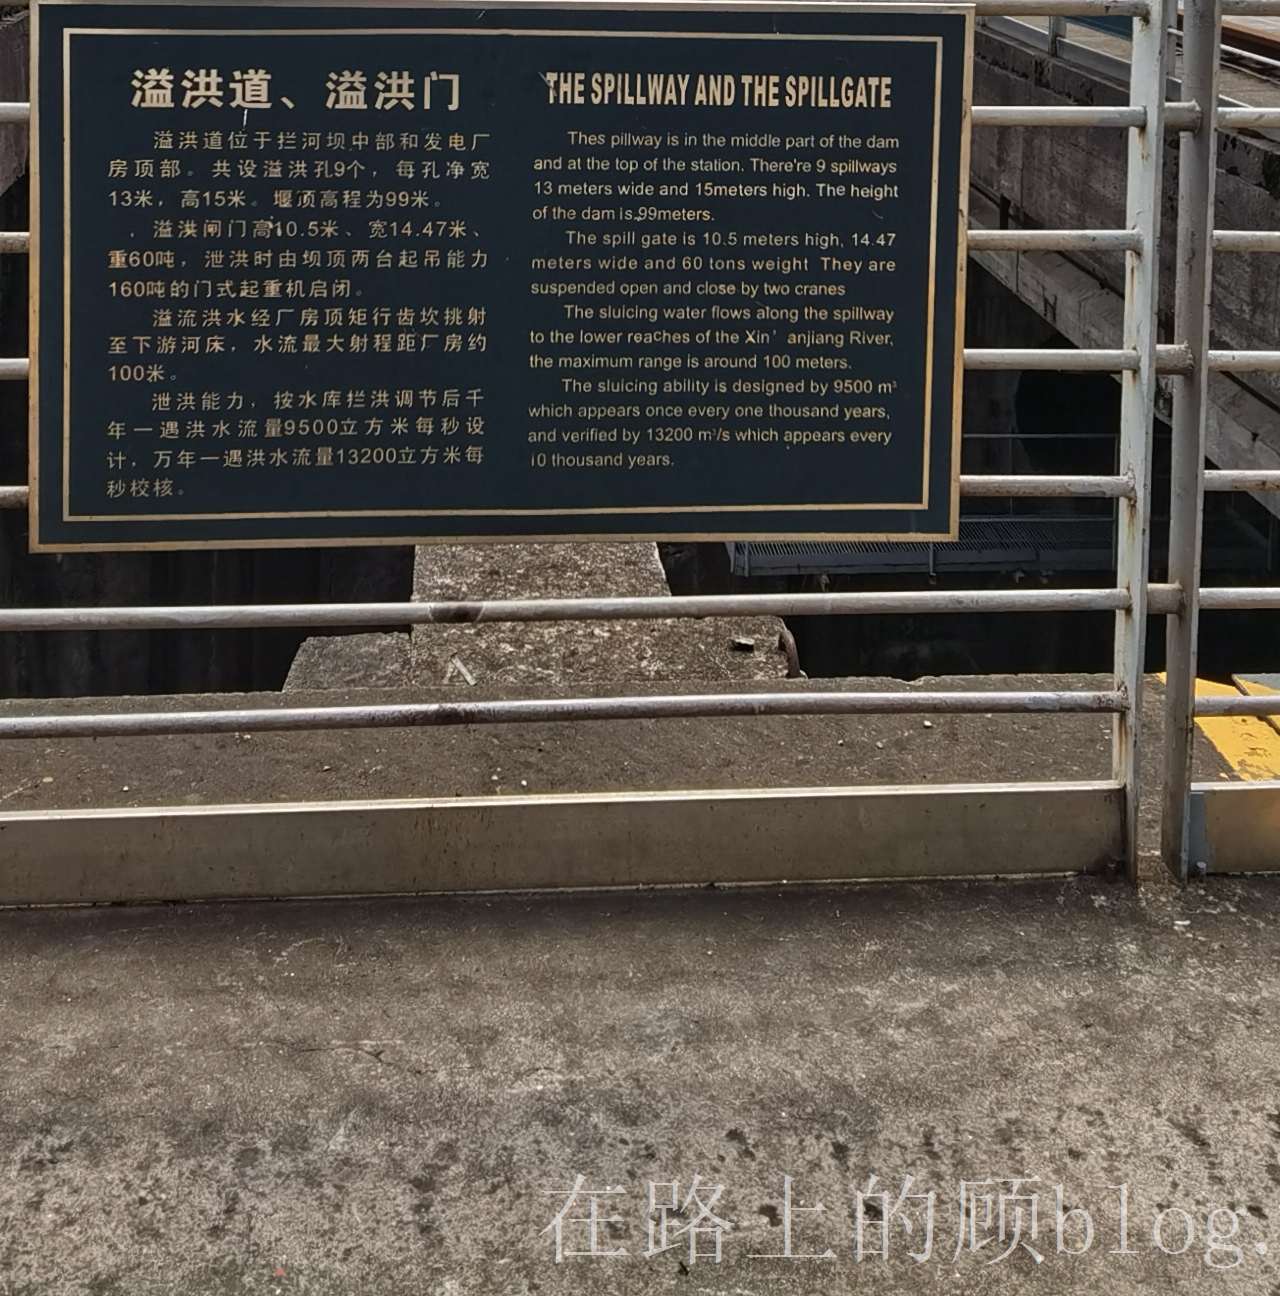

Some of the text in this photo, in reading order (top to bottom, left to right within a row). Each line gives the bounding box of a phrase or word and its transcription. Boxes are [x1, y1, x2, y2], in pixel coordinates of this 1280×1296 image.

[130, 66, 460, 113] 溢洪道、溢洪门
[545, 72, 892, 108] THE SPILLWAY AND THE SPILLGATE
[153, 129, 491, 152] 溢洪道位于拦河坝中部和发电厂
[566, 130, 900, 151] Thes pillway is in the middle part of the dam
[533, 156, 898, 177] and at the top of the station. There're 9 spillways
[534, 180, 899, 202] 13 meters wide and 15meters high. The height
[532, 205, 549, 220] of
[551, 205, 577, 221] the
[581, 205, 616, 221] dam
[565, 230, 897, 250] The spill gate is 10.5 meters high, 14.47
[531, 255, 897, 275] meters wide and 60 tons weight They are
[108, 278, 362, 299] 160吨的门式起重机启闭。
[530, 280, 846, 299] suspended open and close by two cranes
[152, 306, 487, 328] 溢流洪水经厂房顶矩行齿坎挑射
[563, 304, 895, 324] The sluicing water flows along the spillway
[529, 329, 545, 344] to
[549, 329, 575, 344] the
[579, 329, 623, 344] lower
[627, 329, 691, 344] reaches
[695, 329, 712, 344] of
[715, 329, 740, 344] the
[787, 330, 845, 348] anjiang
[529, 353, 852, 372] the maximum range is around 100 meters.
[108, 363, 177, 383] 100米。
[561, 378, 593, 393] The
[597, 378, 658, 396] sluicing
[662, 378, 710, 397] ability
[714, 378, 728, 393] is
[732, 378, 805, 397] designed
[810, 379, 829, 397] by
[833, 379, 873, 394] 9500
[528, 403, 890, 421] which appears once every one thousand years,
[107, 416, 485, 440] 年一遇洪水流量9500立方米每秒设
[527, 428, 557, 443] and
[561, 427, 618, 443] verified
[622, 427, 641, 445] by
[646, 426, 693, 442] 13200
[734, 427, 779, 442] which
[783, 430, 846, 445] appears
[849, 431, 893, 446] every
[551, 452, 623, 468] thousand
[627, 454, 675, 470] years.
[106, 477, 184, 499] 秒校核。
